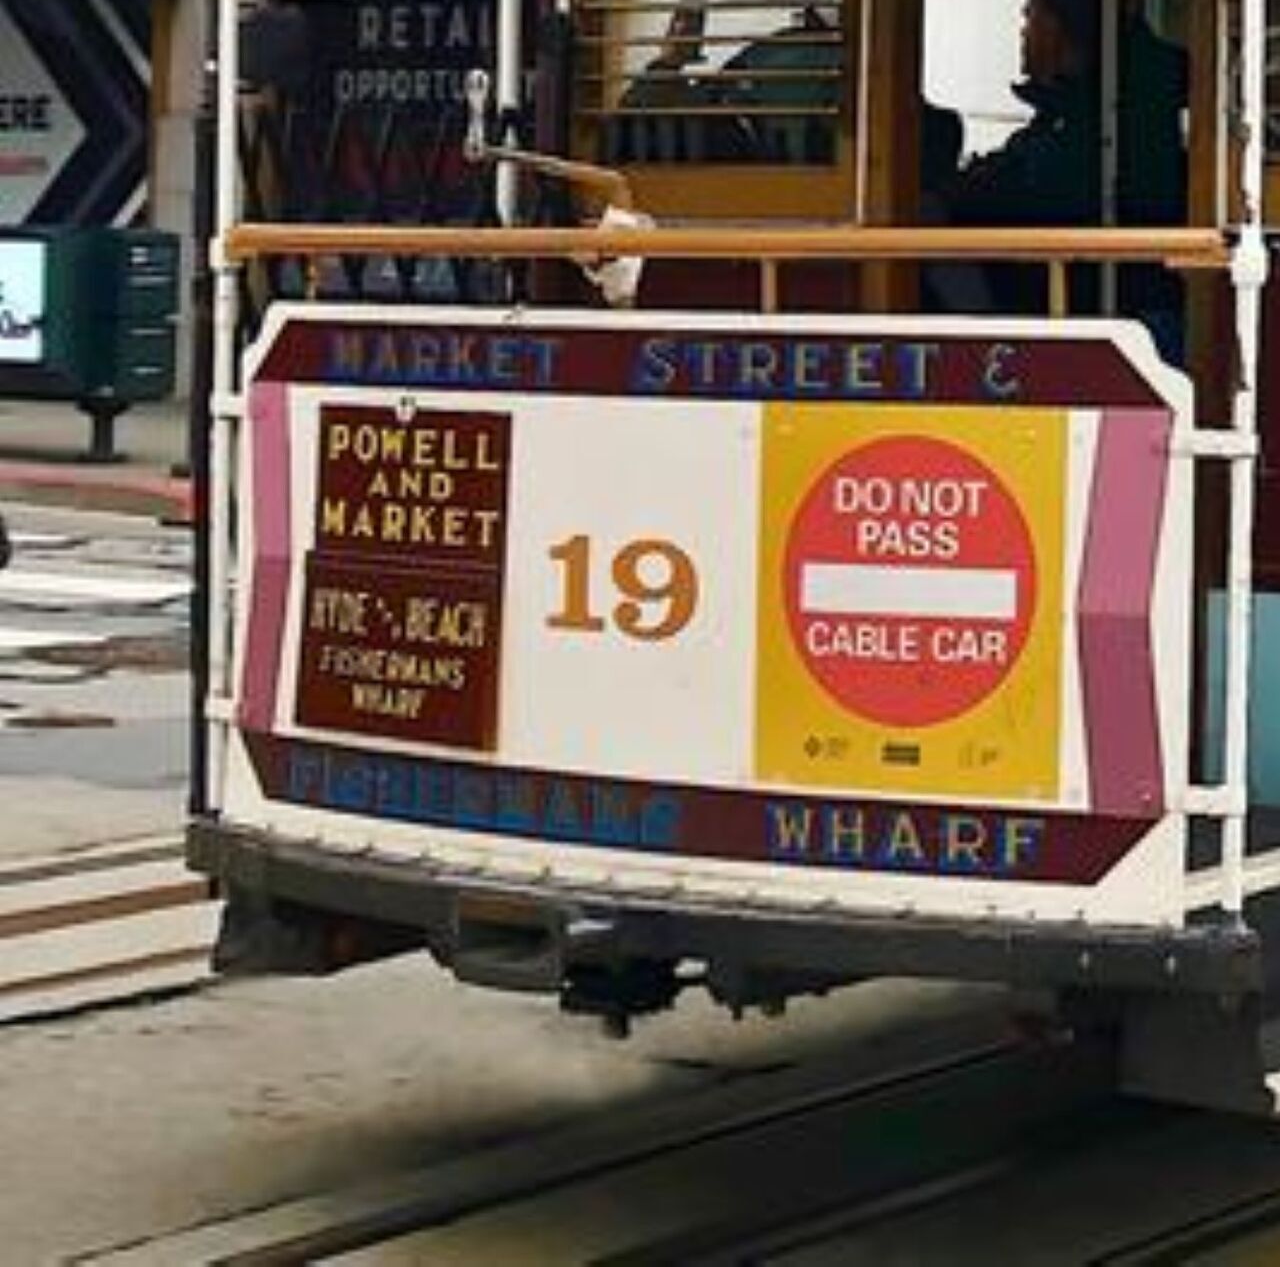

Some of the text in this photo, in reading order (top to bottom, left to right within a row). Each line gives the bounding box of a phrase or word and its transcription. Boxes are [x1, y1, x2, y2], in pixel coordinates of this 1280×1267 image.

[358, 4, 492, 50] RETAI
[328, 331, 563, 387] MARKET
[635, 340, 940, 393] STREET
[327, 423, 499, 471] POWELL
[366, 470, 452, 501] AND
[833, 476, 989, 518] DO NOT
[320, 499, 499, 548] MARKET
[857, 519, 960, 558] PASS
[543, 532, 700, 643] 19
[403, 596, 486, 649] BEACH
[805, 621, 1008, 666] CABLE CAR
[317, 643, 466, 692] FISHERMANS
[768, 799, 1047, 870] WHARF
